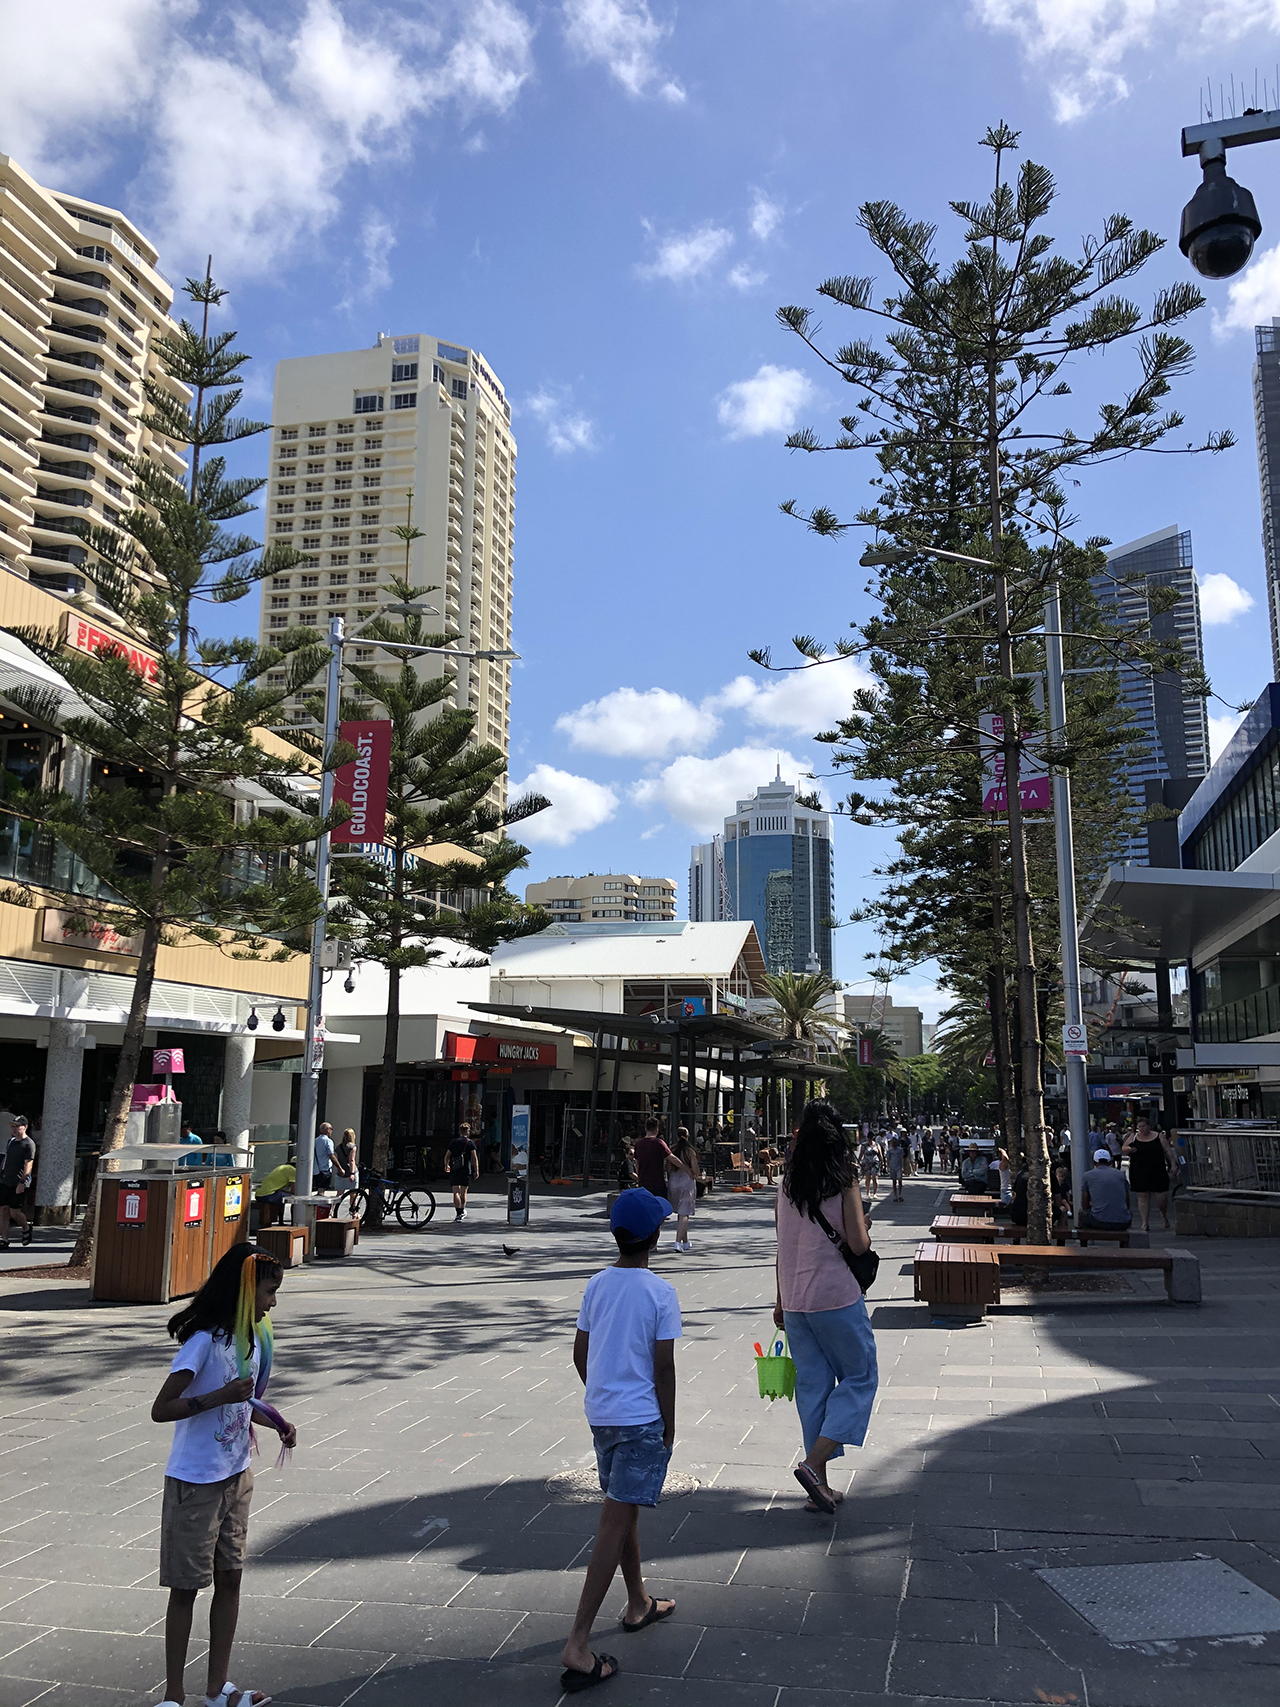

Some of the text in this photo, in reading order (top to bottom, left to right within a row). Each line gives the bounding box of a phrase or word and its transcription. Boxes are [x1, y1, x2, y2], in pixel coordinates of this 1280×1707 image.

[77, 622, 87, 648] TGI
[993, 789, 1038, 801] HTA
[499, 1044, 523, 1059] HUNGRY
[1237, 1084, 1249, 1100] Store
